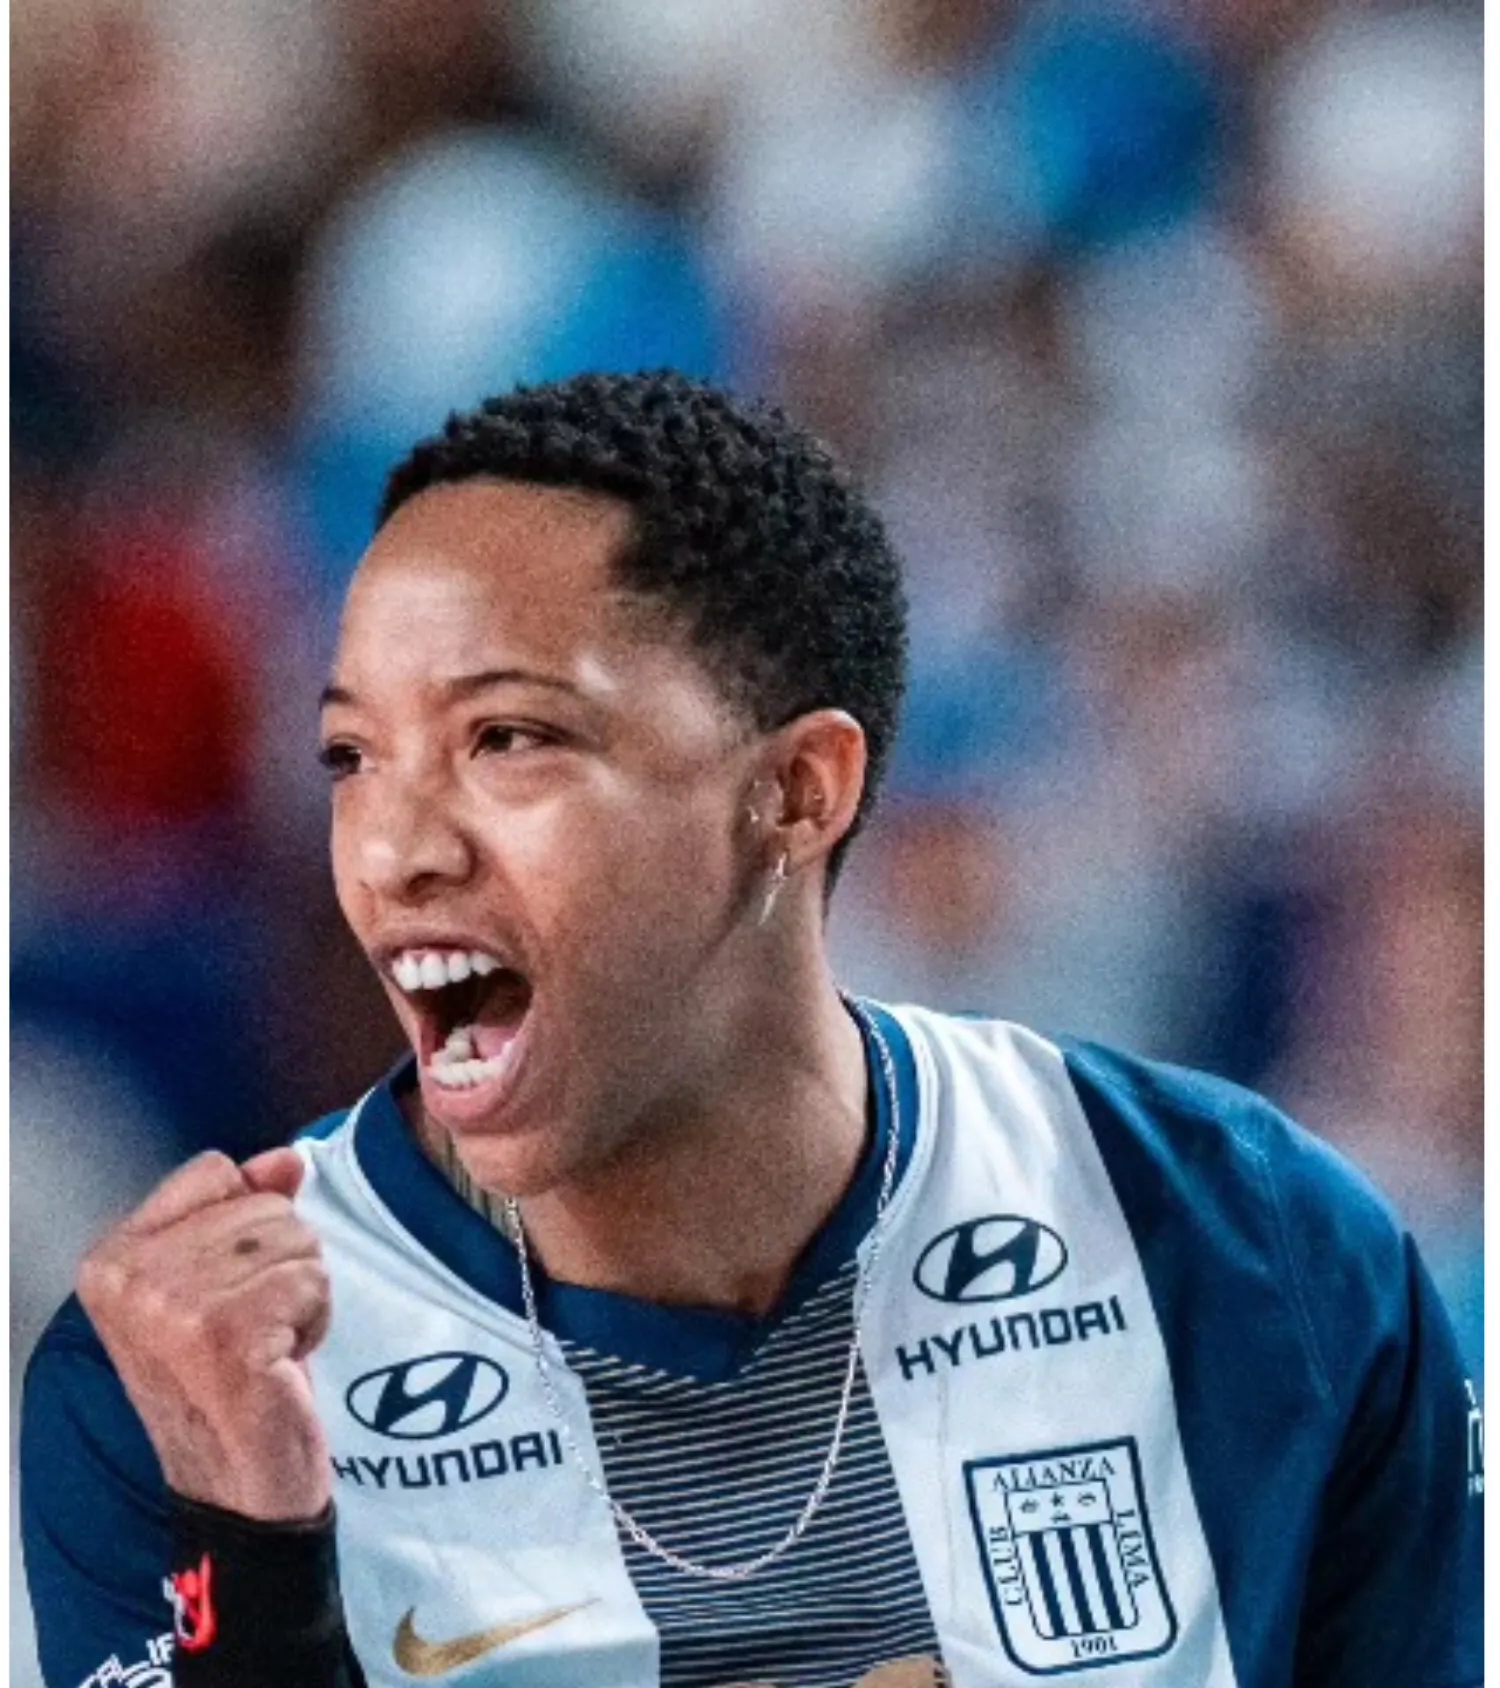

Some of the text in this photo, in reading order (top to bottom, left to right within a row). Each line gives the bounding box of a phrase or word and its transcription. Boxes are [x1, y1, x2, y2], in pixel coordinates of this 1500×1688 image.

[896, 1295, 1127, 1381] HYUNDAI
[331, 1430, 563, 1488] HYUNDAI
[993, 1456, 1117, 1493] ALIANZA
[989, 1526, 1024, 1606] CLUB
[1116, 1508, 1151, 1590] LIMA
[1070, 1634, 1119, 1659] 1901
